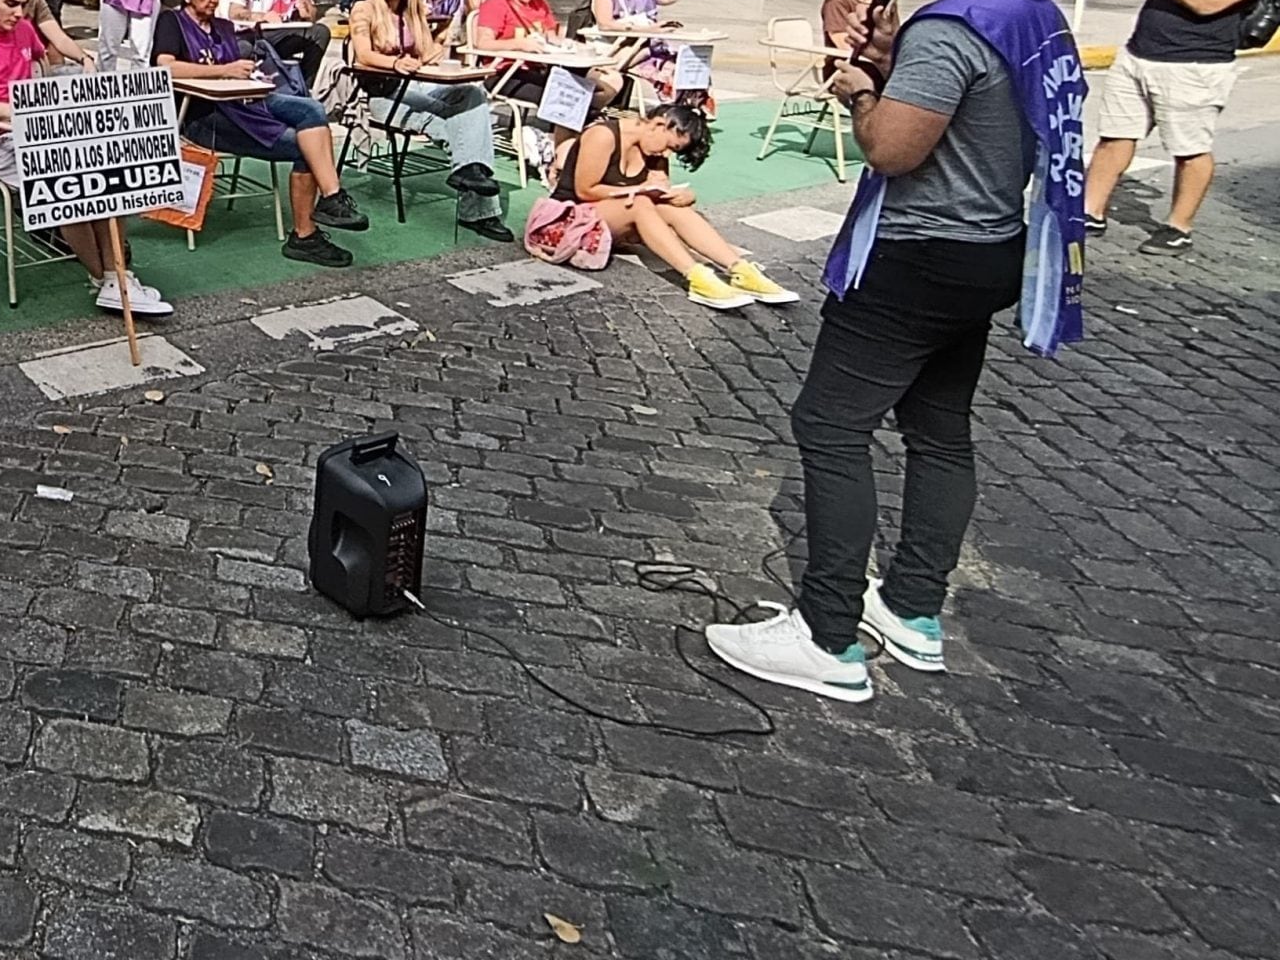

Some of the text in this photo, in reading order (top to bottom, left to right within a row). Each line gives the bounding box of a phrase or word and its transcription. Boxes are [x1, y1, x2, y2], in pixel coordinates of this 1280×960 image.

[13, 81, 59, 109] SALARIO
[71, 75, 120, 103] CANASTA
[123, 70, 169, 97] FAMILIAR
[25, 103, 167, 142] JUBILACION 85% MOVIL
[22, 134, 176, 177] SALARIO A LOS AD-HONOREM
[28, 190, 184, 225] en CONADU histórica
